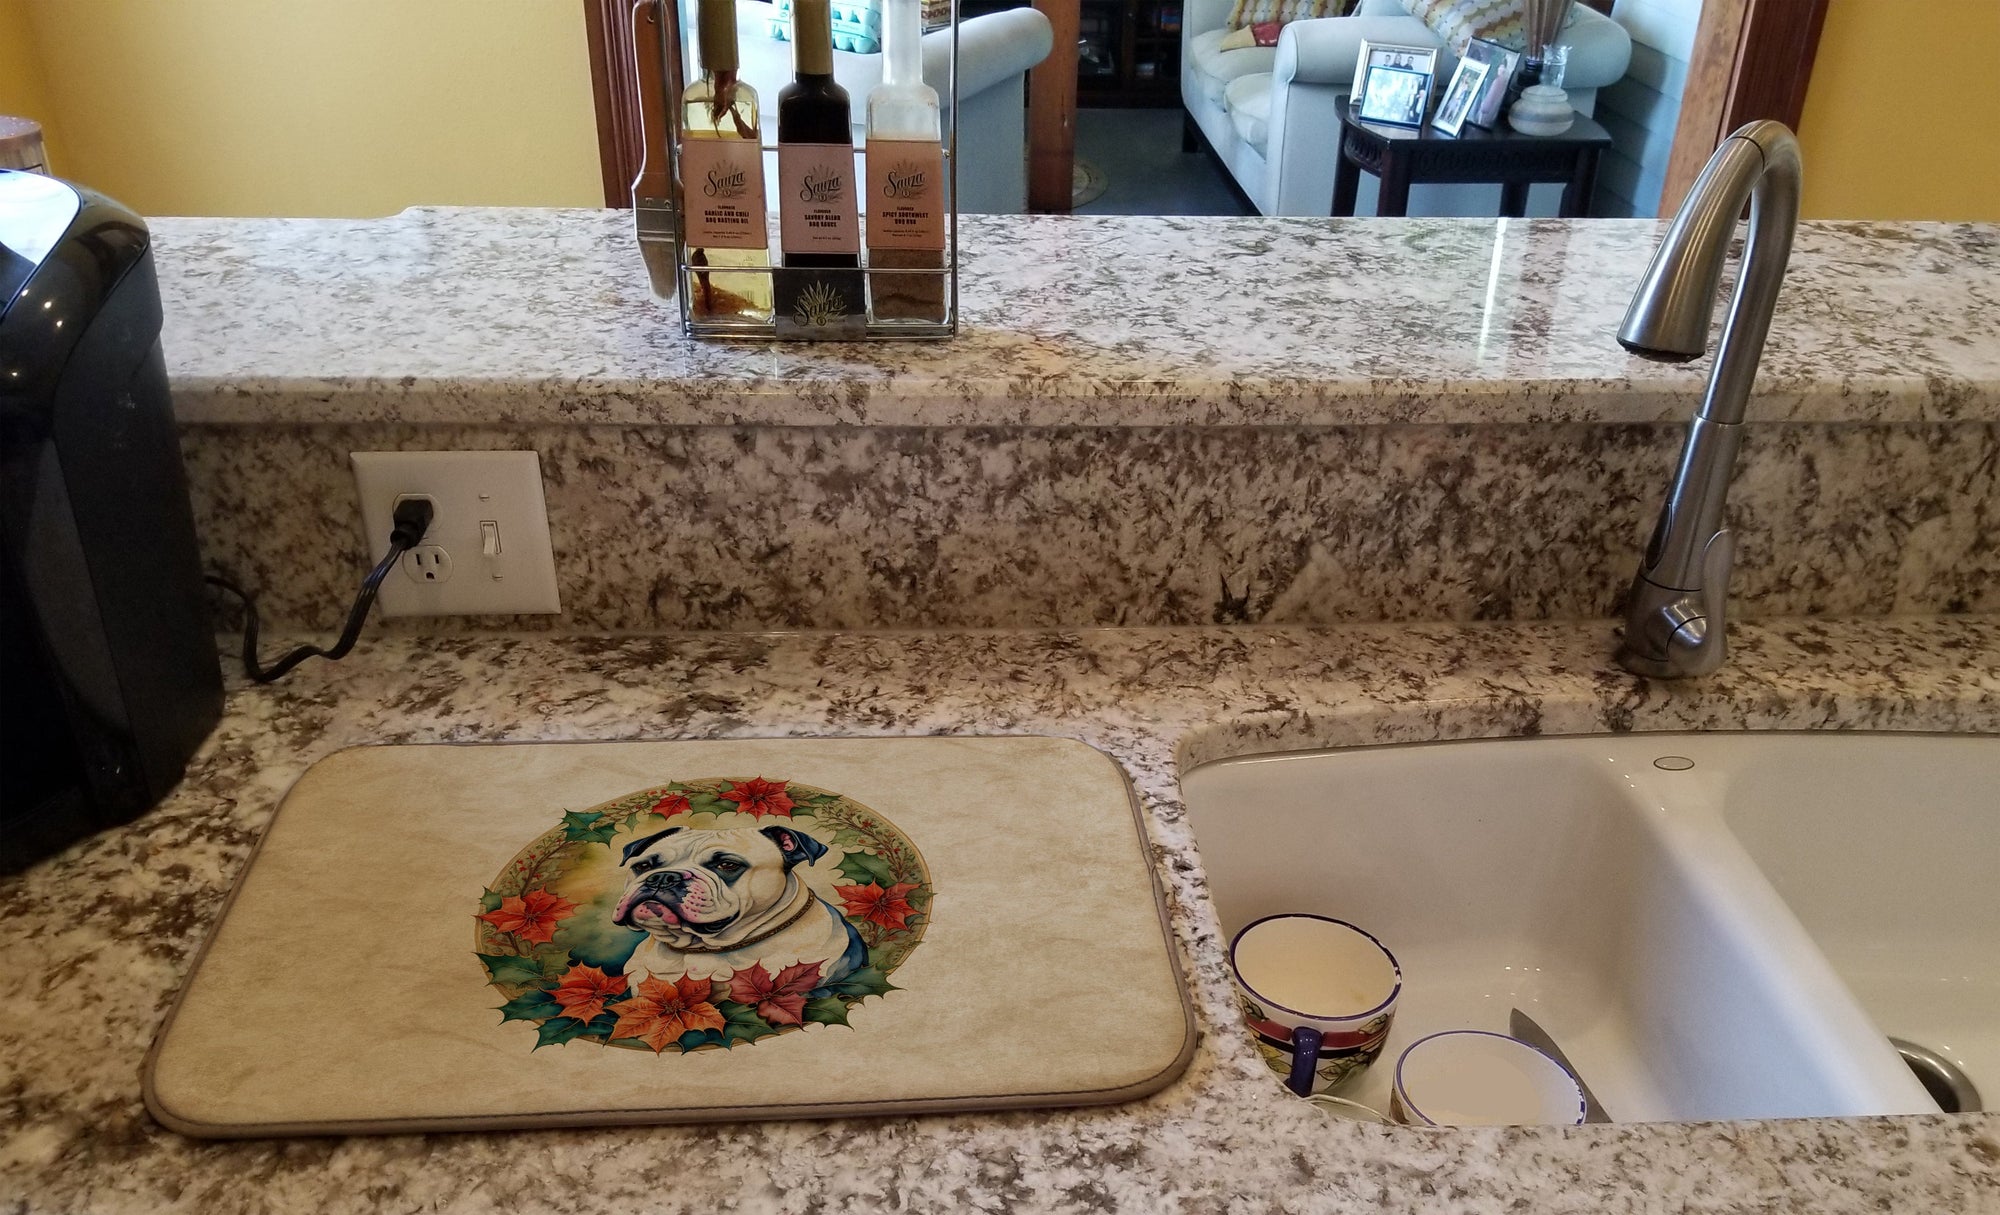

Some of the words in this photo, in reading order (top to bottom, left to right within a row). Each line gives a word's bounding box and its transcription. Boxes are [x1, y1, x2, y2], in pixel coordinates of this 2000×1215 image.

[703, 170, 745, 197] Sauza
[800, 175, 842, 202] Sauza
[883, 171, 925, 198] Sauza
